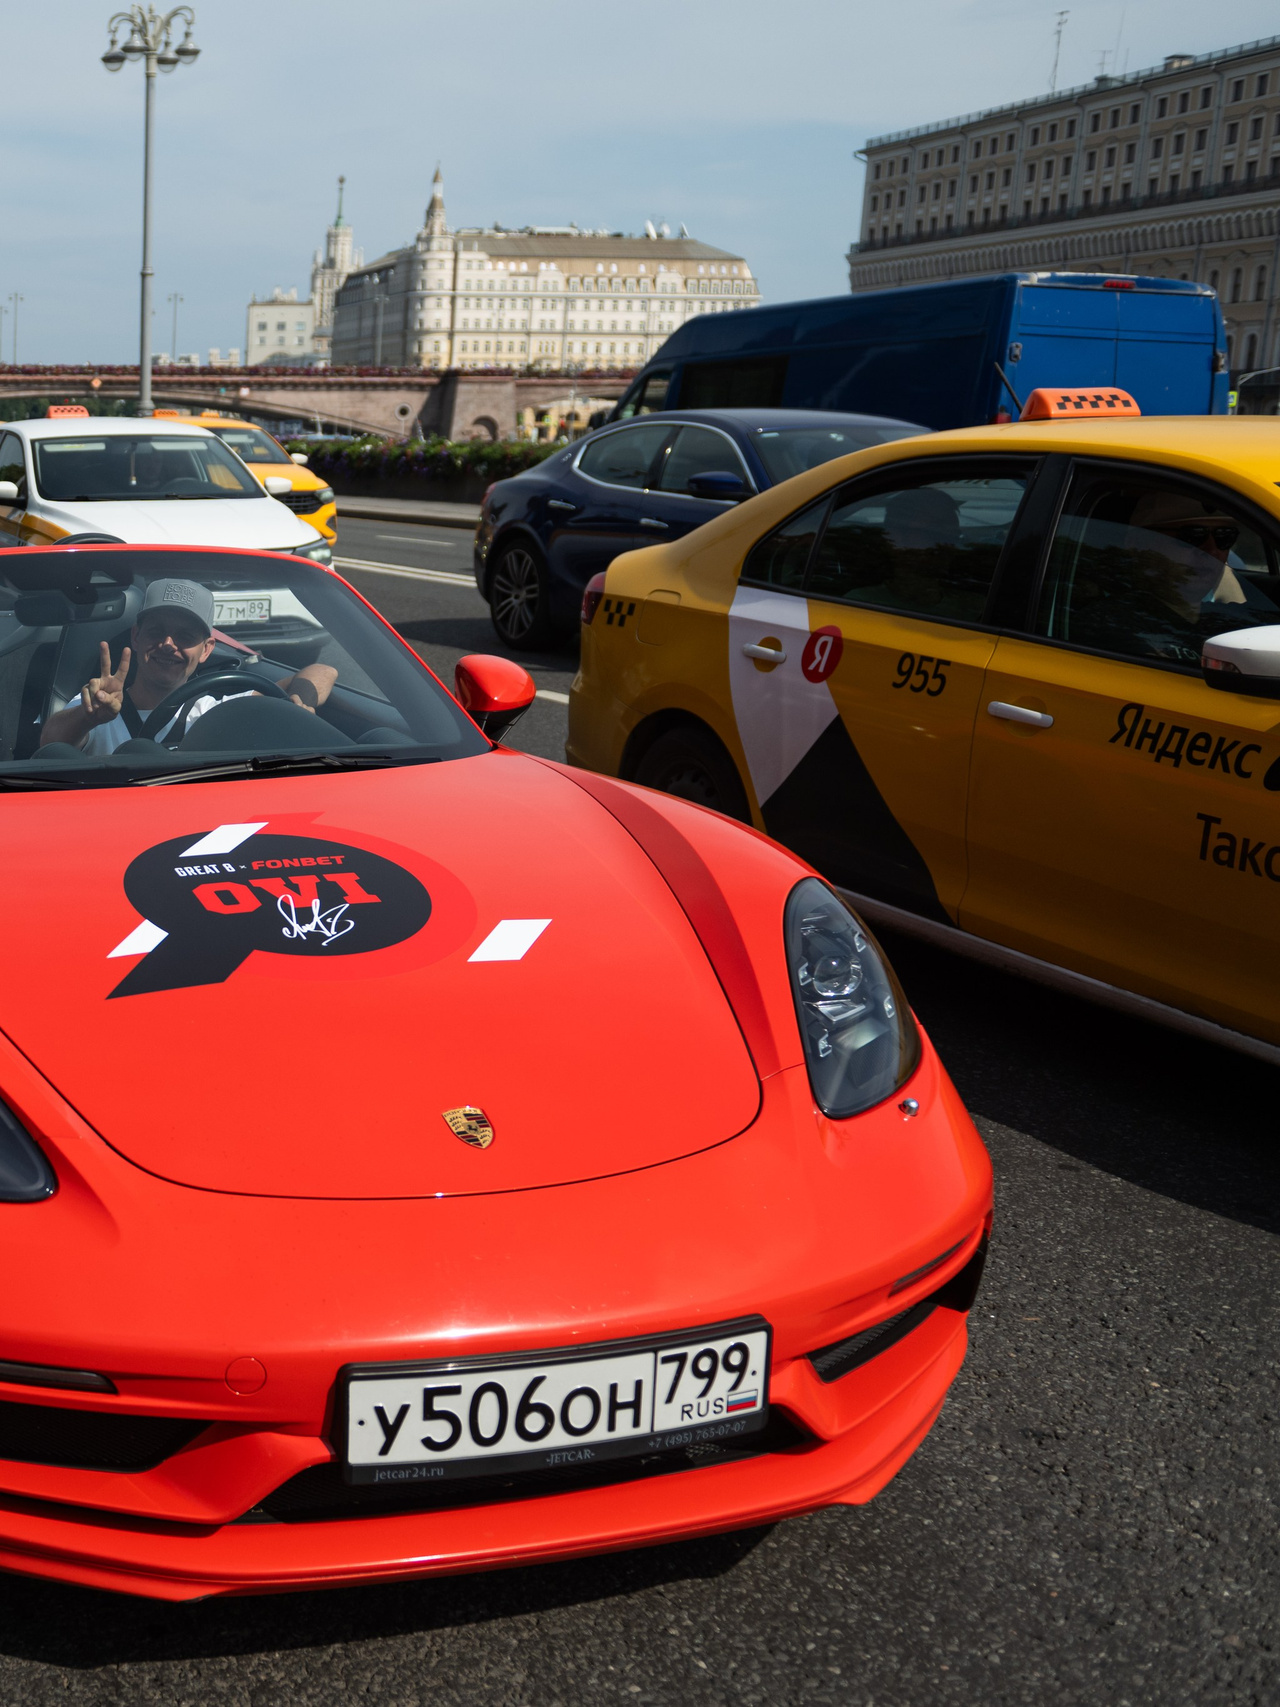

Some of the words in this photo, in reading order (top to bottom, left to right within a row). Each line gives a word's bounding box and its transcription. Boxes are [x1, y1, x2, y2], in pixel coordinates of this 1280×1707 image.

[215, 603, 246, 619] 7ТМ
[249, 602, 264, 614] 89
[808, 635, 833, 673] Я
[892, 652, 952, 697] 955
[1108, 702, 1262, 779] Яндекс
[174, 864, 221, 877] GREAT
[251, 855, 345, 870] FONBET
[192, 872, 382, 915] OVI
[661, 1342, 750, 1404] 799
[681, 1398, 724, 1421] RUS
[373, 1466, 444, 1482] jetcar24.ru
[648, 1437, 662, 1449] +7
[665, 1431, 693, 1447] (495)
[696, 1420, 747, 1441] 765-07-07
